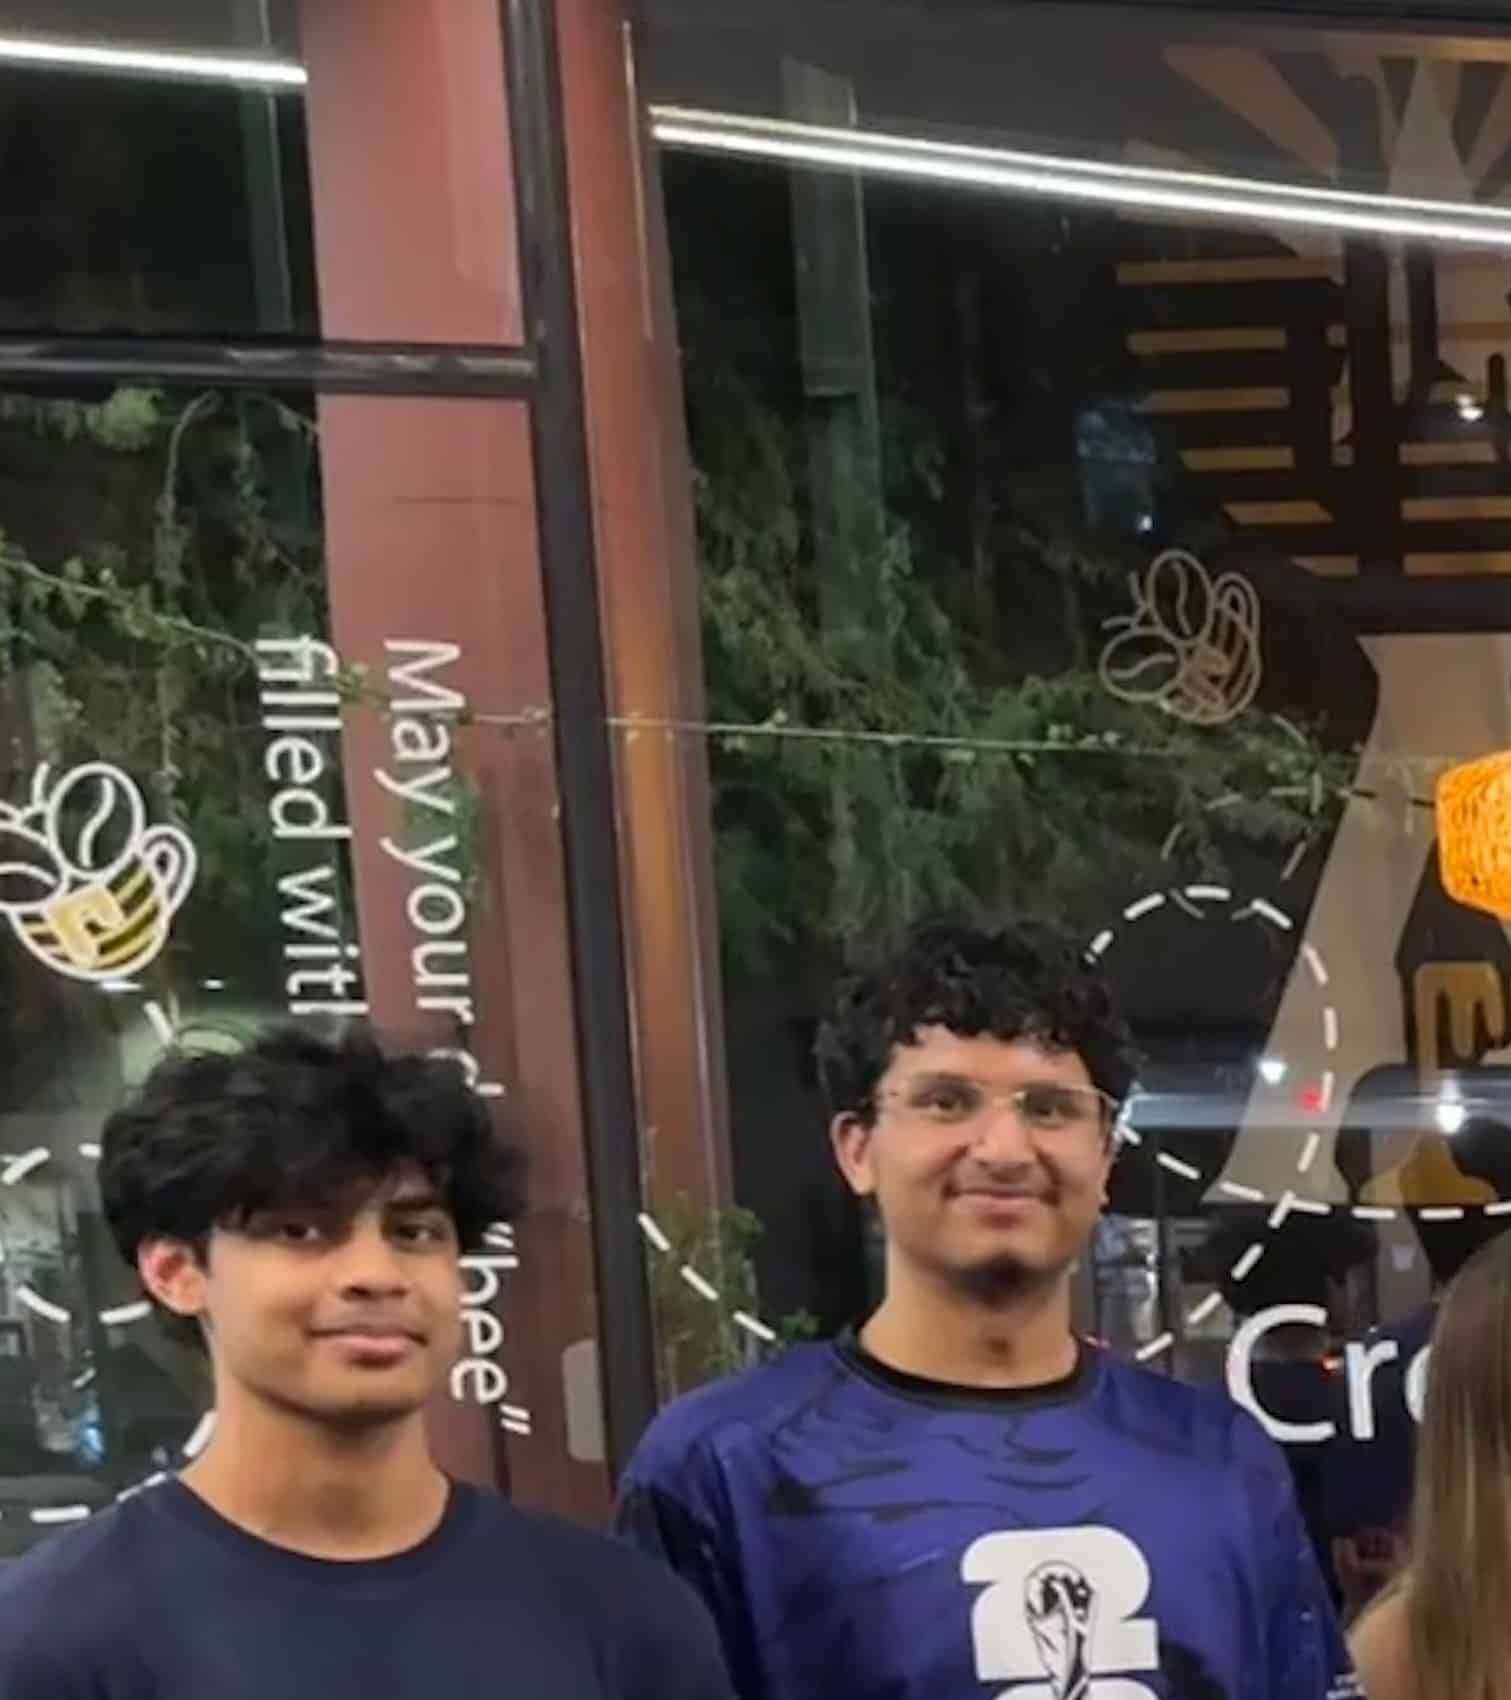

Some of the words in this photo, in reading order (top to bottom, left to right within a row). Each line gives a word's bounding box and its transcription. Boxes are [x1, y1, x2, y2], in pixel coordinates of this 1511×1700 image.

[256, 633, 353, 838] filled
[373, 637, 466, 813] May
[379, 836, 476, 1025] your
[1226, 1304, 1430, 1442] Cr
